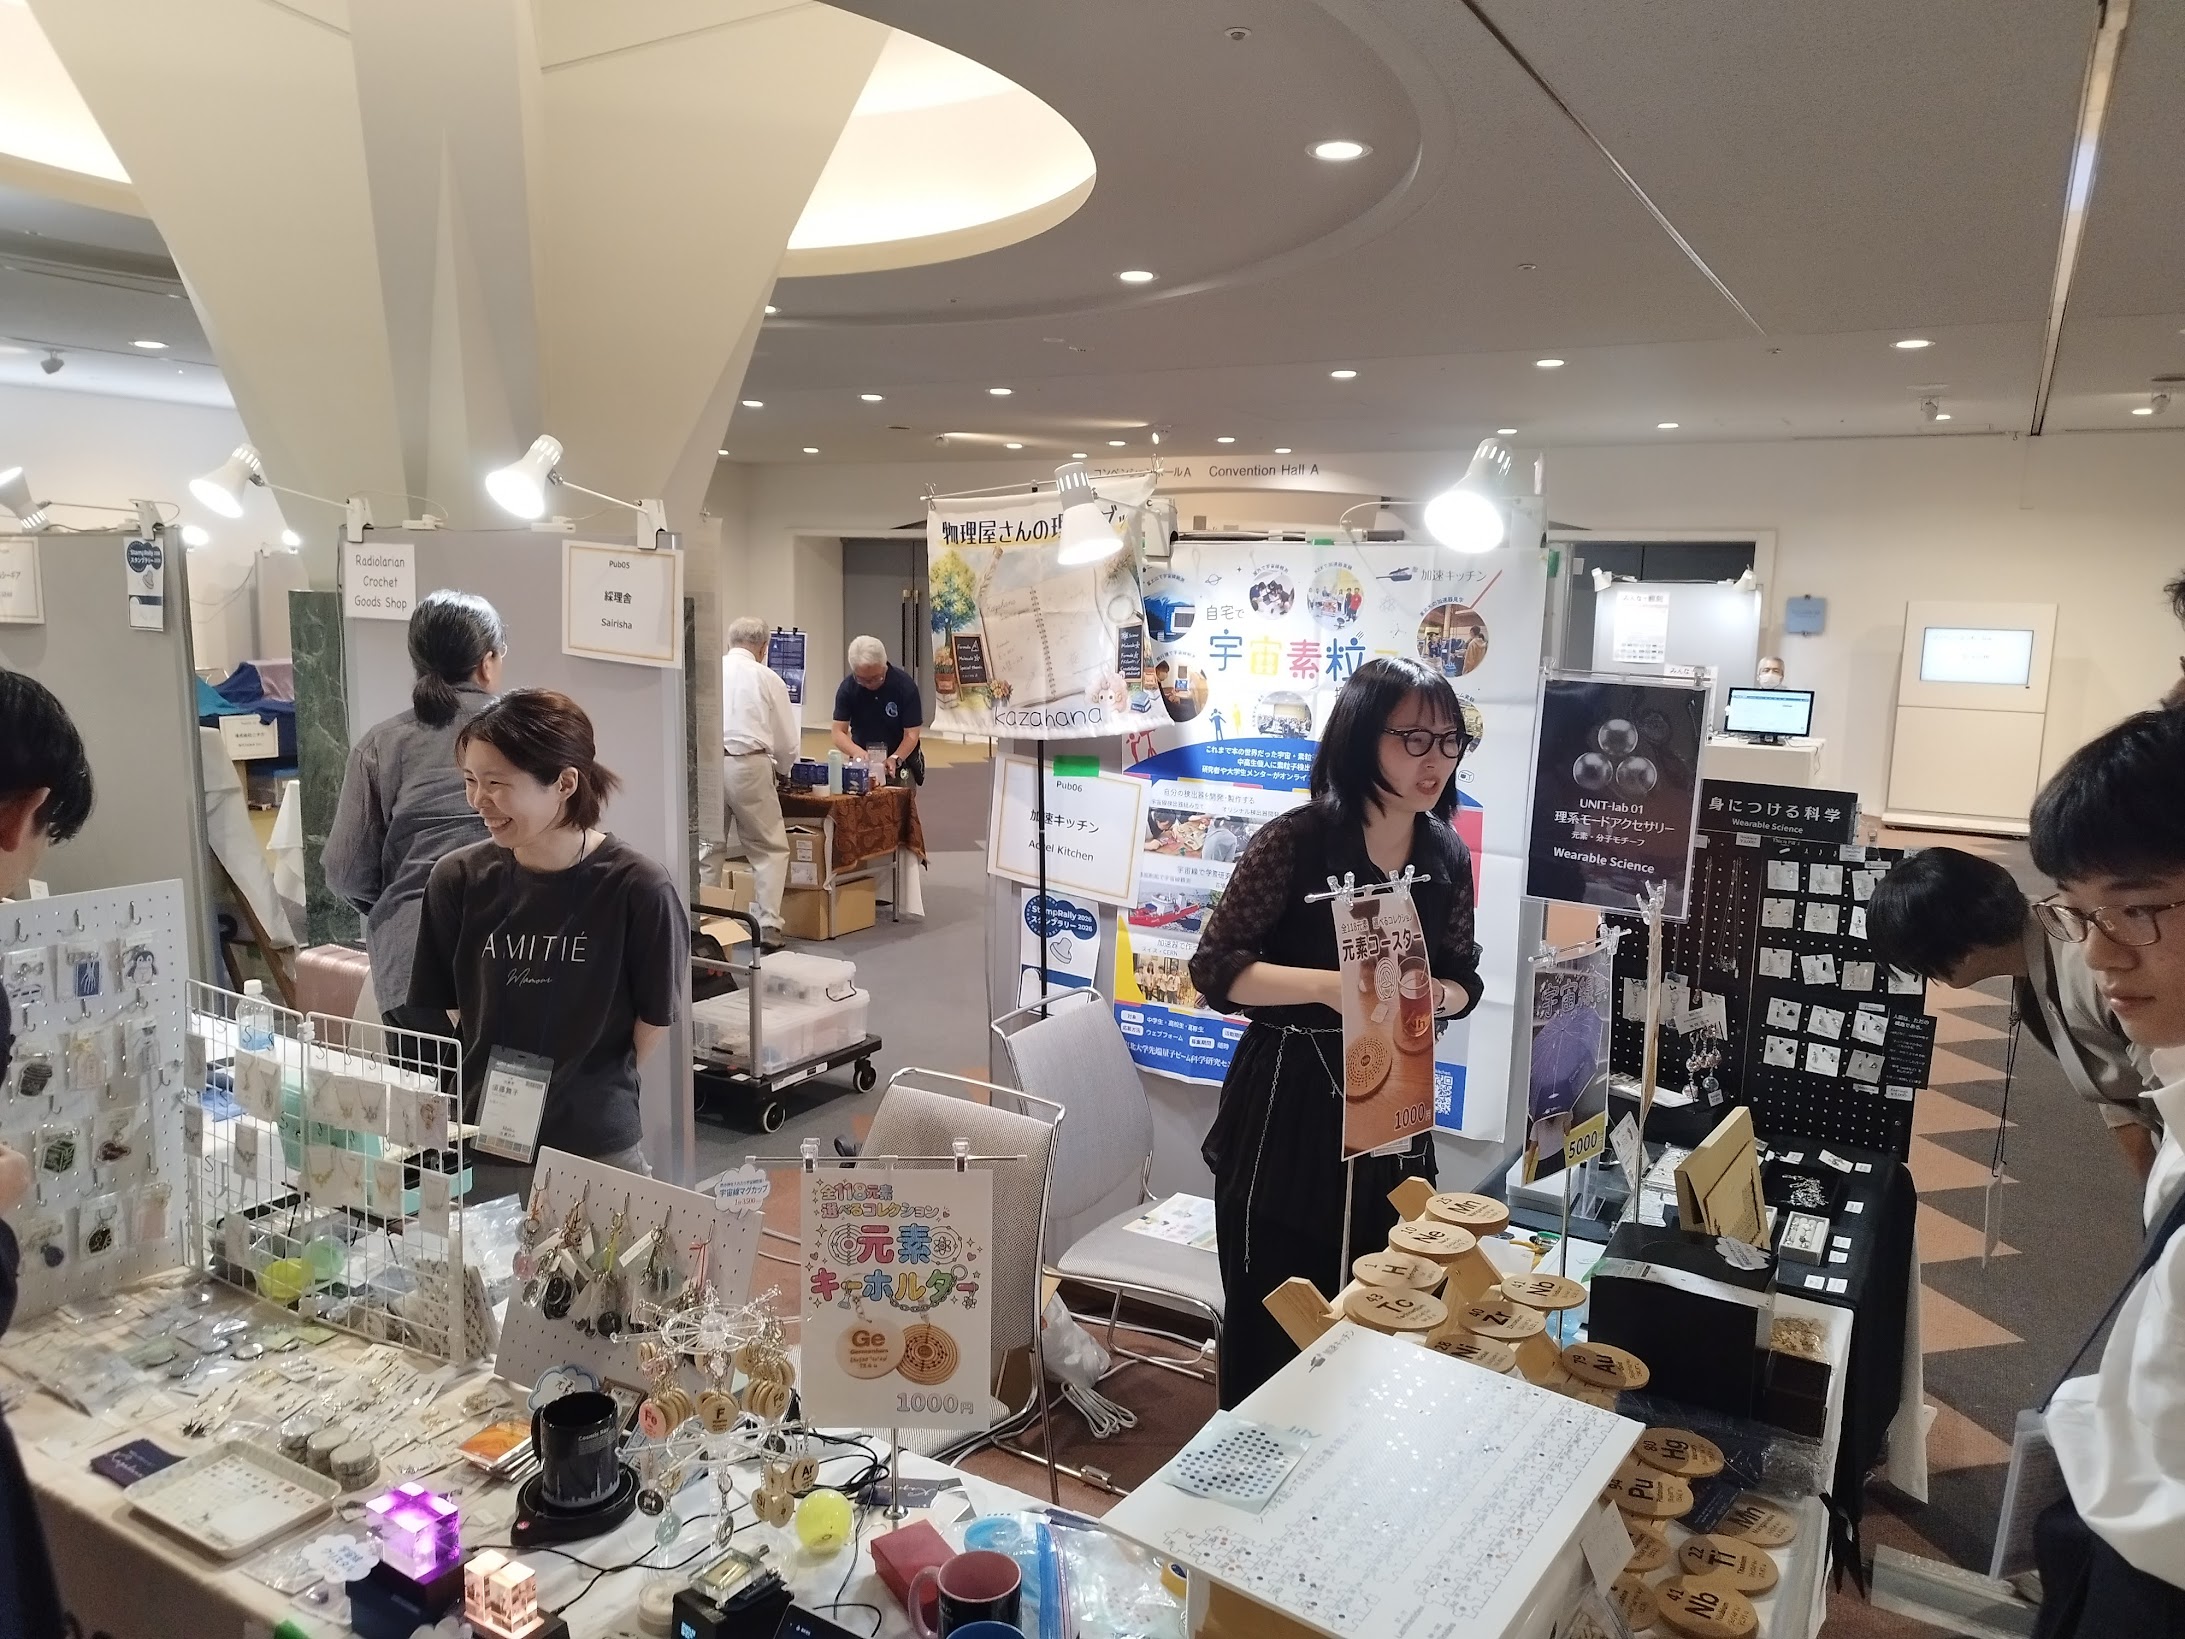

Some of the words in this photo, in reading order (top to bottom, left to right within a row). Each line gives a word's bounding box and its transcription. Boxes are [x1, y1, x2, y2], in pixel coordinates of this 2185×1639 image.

[1209, 465, 1275, 478] Convention
[1281, 464, 1305, 476] Hall
[1310, 464, 1319, 476] A
[355, 554, 405, 568] Radiolarian
[609, 560, 630, 569] Pub05
[363, 575, 398, 588] Crochet
[1420, 569, 1489, 584] 加速キッチン
[354, 595, 381, 608] Goods
[385, 597, 407, 612] Shop
[1206, 604, 1245, 621] 自宅で
[601, 618, 632, 630] Sairisha
[994, 706, 1103, 728] kazahana
[1056, 780, 1083, 793] Pub06
[1579, 798, 1629, 813] UNIT-lab
[1630, 804, 1644, 815] 01
[1709, 796, 1842, 823] 身につける科学
[1554, 810, 1675, 833] 理系モードアクセサリー
[1732, 818, 1770, 830] Wearable
[1771, 823, 1804, 834] Science
[1571, 830, 1646, 847] 元素・分子モチーフ
[1057, 846, 1094, 862] Kitchen
[1553, 846, 1608, 866] Wearable
[1609, 856, 1655, 874] Science
[1032, 905, 1076, 921] StmpRally
[481, 931, 588, 962] AMITIÉ
[1342, 927, 1422, 962] 元素コースター
[820, 1183, 894, 1201] 全118元素
[1436, 1196, 1452, 1205] 25
[1446, 1200, 1481, 1215] Mn
[821, 1202, 940, 1219] 選べるコレクション
[1400, 1226, 1417, 1235] 10
[1412, 1230, 1445, 1244] Ne
[856, 1223, 933, 1265] 元素
[1381, 1264, 1408, 1276] H
[810, 1267, 980, 1302] キーホルダー
[1510, 1280, 1526, 1289] 41
[1526, 1281, 1555, 1297] Nb
[1366, 1293, 1384, 1303] 43
[1376, 1298, 1414, 1313] Tc
[1468, 1308, 1485, 1318] 40
[1482, 1310, 1511, 1326] Zr
[851, 1330, 886, 1347] Ge
[1434, 1340, 1452, 1350] 28
[1450, 1343, 1481, 1359] Ni
[1573, 1354, 1587, 1365] 79
[1593, 1354, 1617, 1376] Au
[896, 1392, 974, 1415] 1000円
[716, 1408, 725, 1420] F
[1661, 1439, 1688, 1460] Hg
[801, 1465, 814, 1478] Ar
[1628, 1478, 1653, 1500] Pu
[1727, 1506, 1766, 1530] Mn
[1688, 1546, 1704, 1559] 22
[1708, 1550, 1736, 1568] Ti
[1667, 1588, 1684, 1601] 41
[1685, 1592, 1720, 1620] Nb
